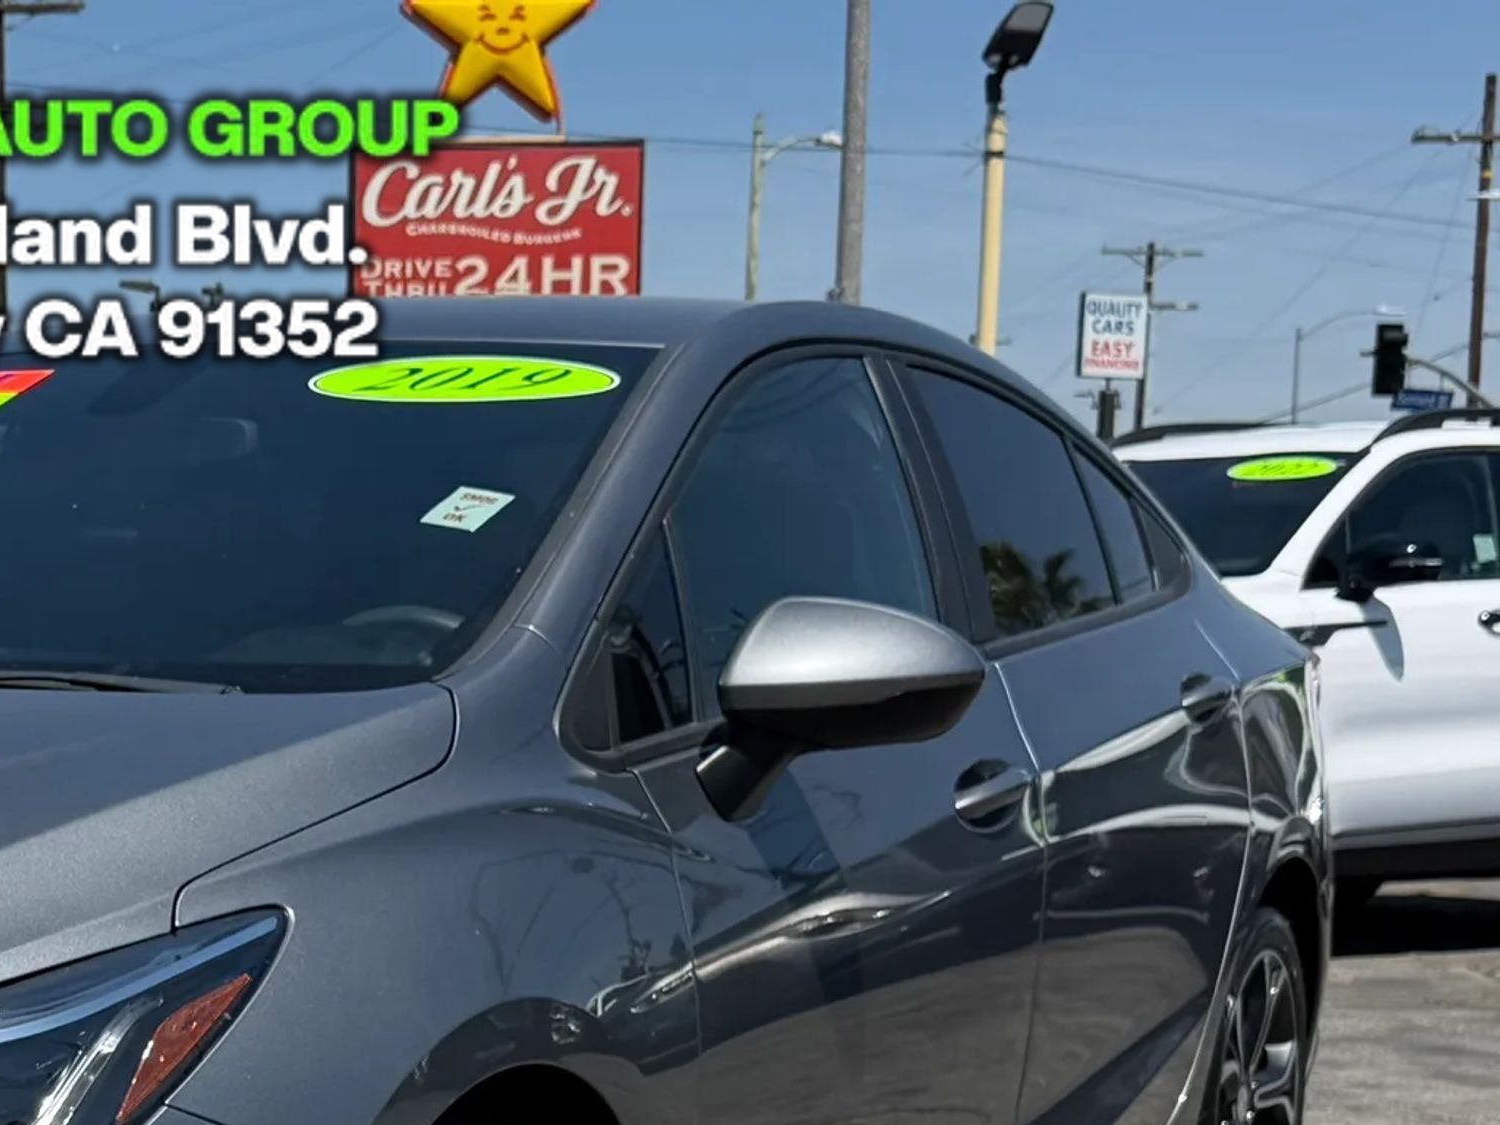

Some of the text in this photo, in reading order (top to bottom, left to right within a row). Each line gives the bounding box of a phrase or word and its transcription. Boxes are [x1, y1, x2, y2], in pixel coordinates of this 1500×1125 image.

[362, 154, 633, 227] Carl's Jr.
[361, 257, 453, 280] DRIVE
[1086, 299, 1144, 319] QUALITY
[1092, 319, 1135, 337] CARS
[1092, 339, 1135, 358] EASY
[353, 367, 572, 393] 2019
